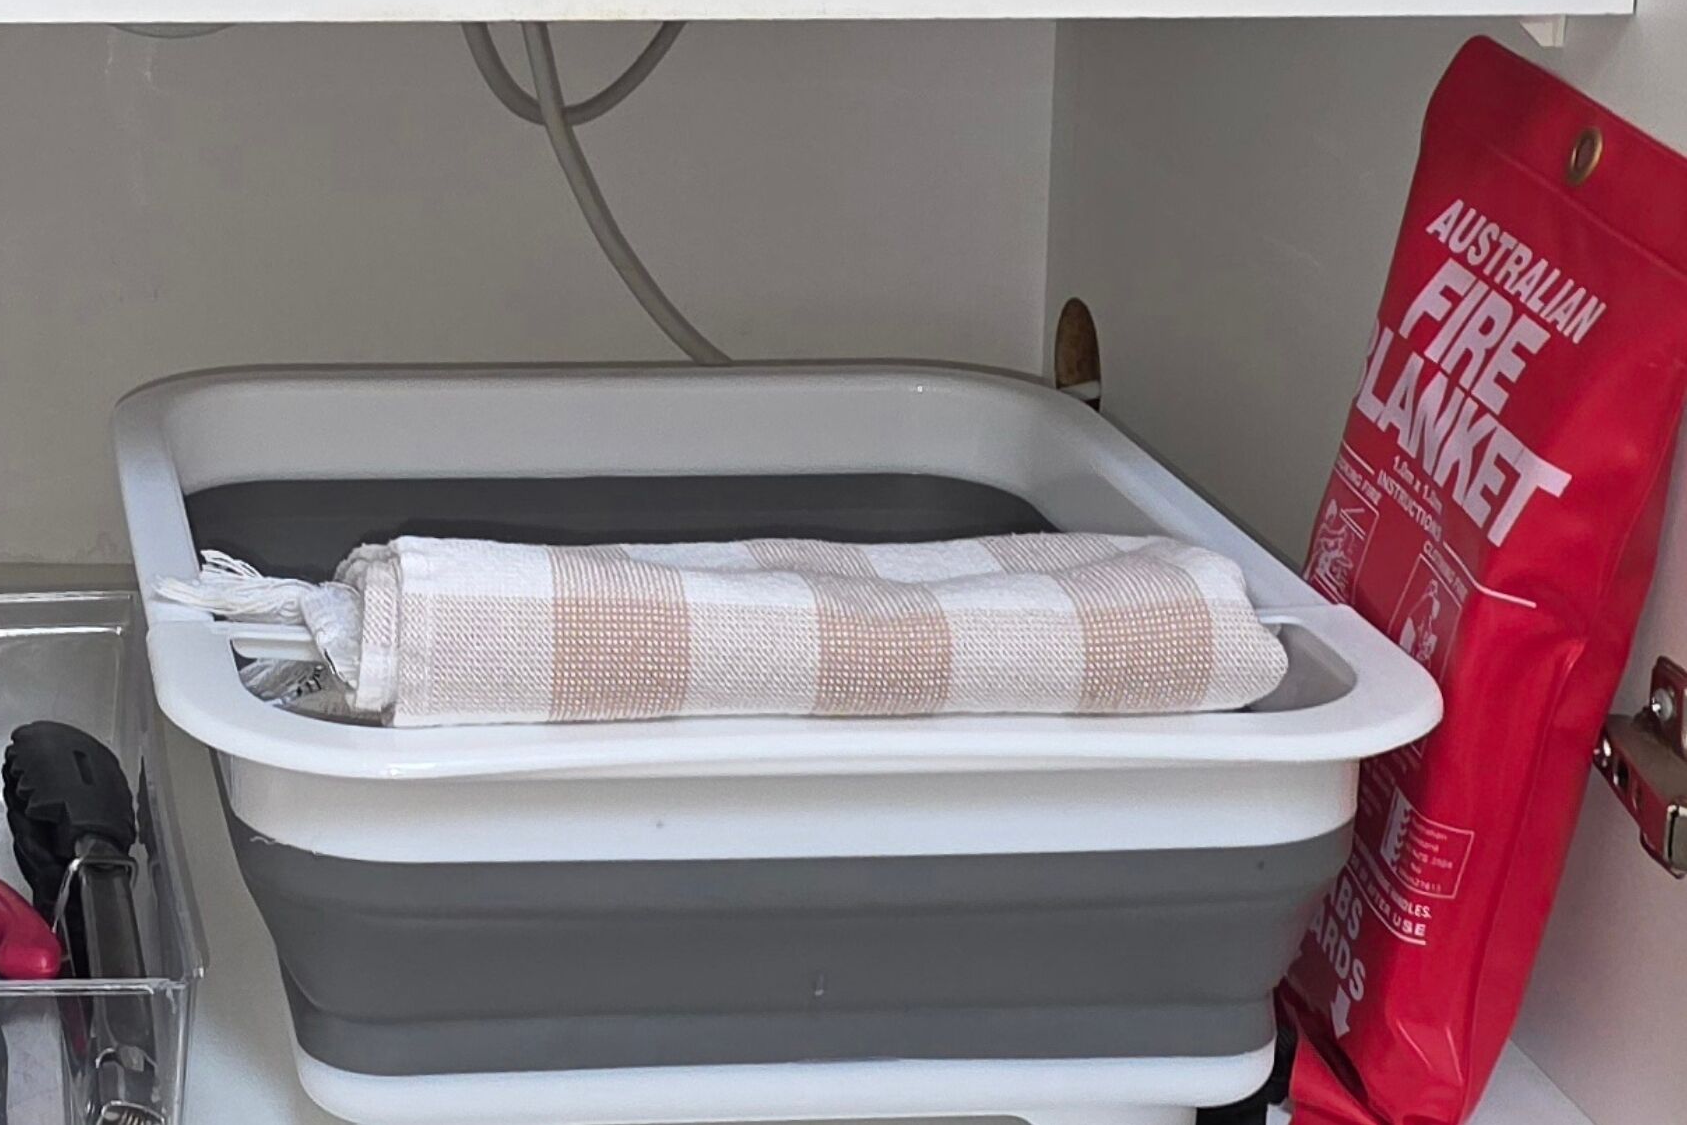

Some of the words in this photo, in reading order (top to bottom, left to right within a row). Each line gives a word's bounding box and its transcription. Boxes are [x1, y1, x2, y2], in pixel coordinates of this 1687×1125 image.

[1398, 258, 1551, 416] FIRE
[1425, 198, 1608, 345] AUSTRALIAN
[1355, 321, 1573, 548] LANKET
[1392, 913, 1427, 938] USE
